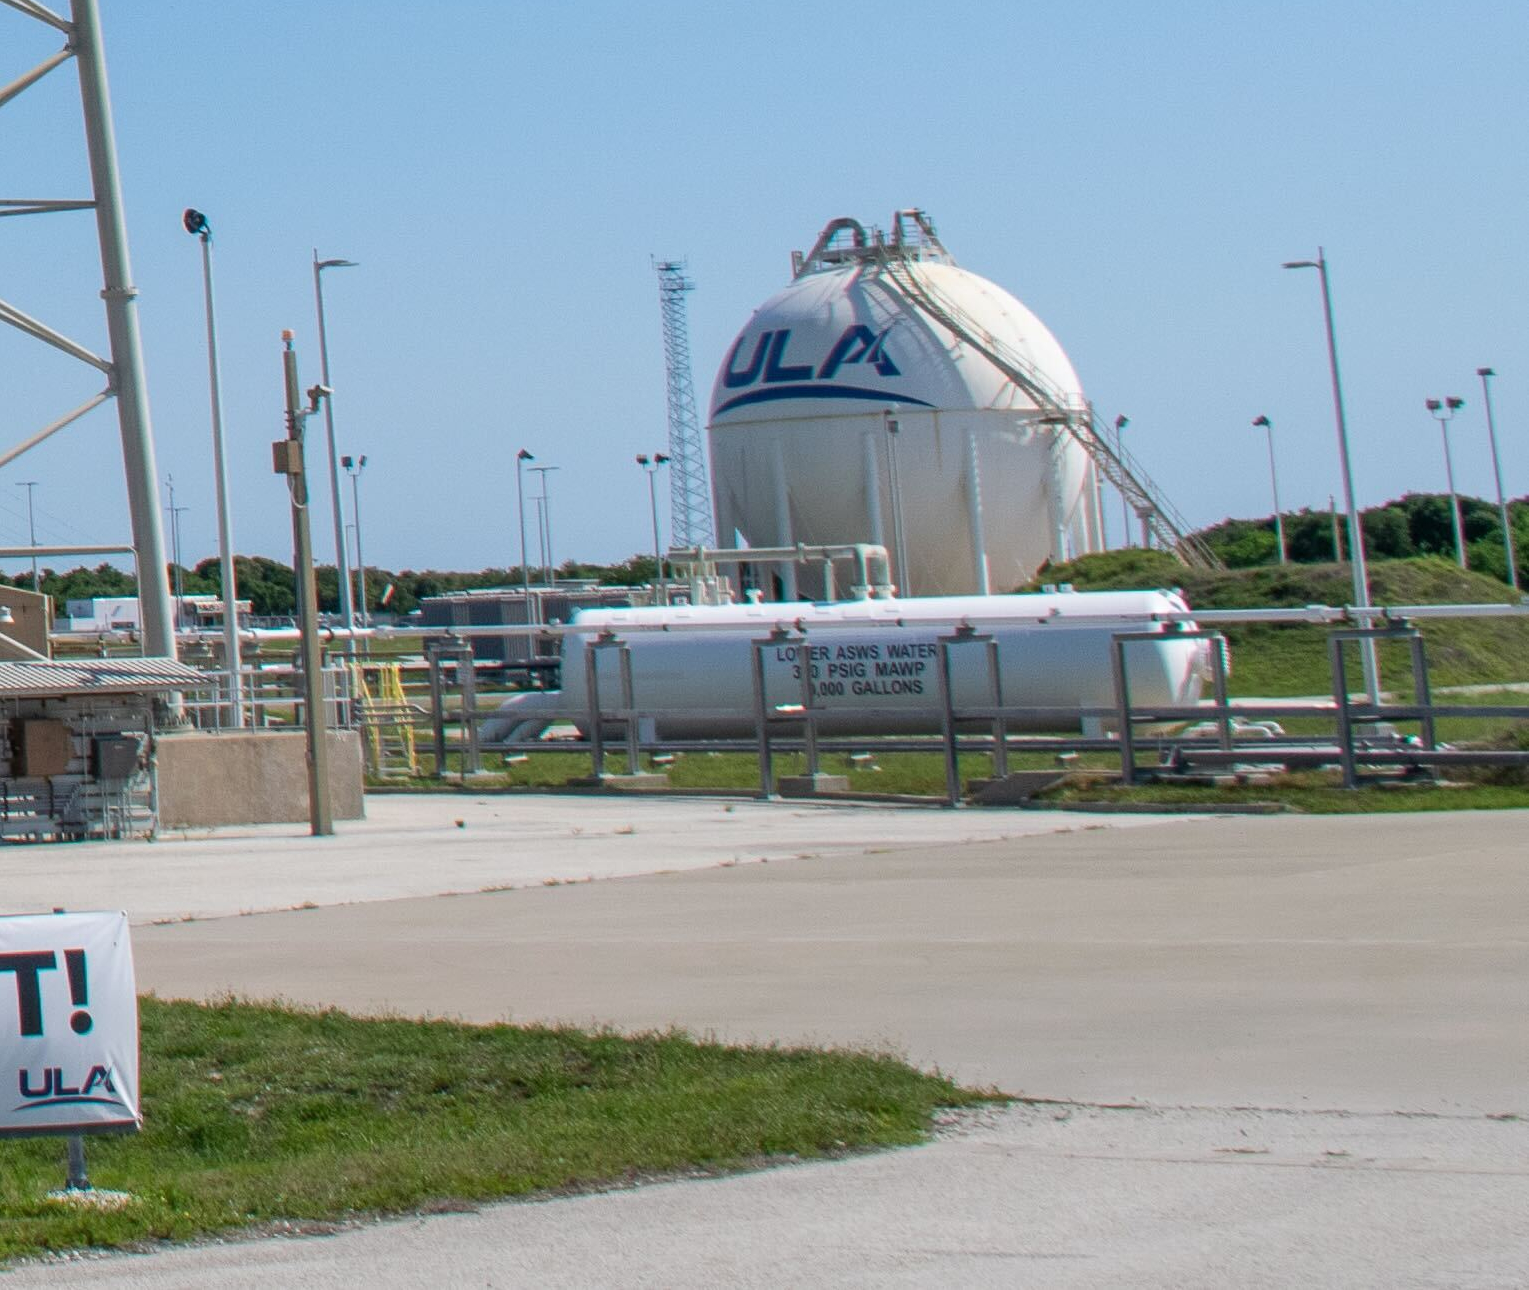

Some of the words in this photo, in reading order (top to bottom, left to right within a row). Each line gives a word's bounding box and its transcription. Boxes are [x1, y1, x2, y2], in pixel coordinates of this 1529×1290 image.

[722, 324, 902, 388] ULA
[776, 646, 830, 661] LOER
[836, 645, 879, 660] ASWS
[887, 643, 939, 659] WATER
[793, 663, 819, 679] 30
[828, 662, 866, 678] PSIG
[875, 662, 926, 678] MAWP
[851, 680, 924, 695] GALLONS
[19, 1065, 117, 1098] ULA
